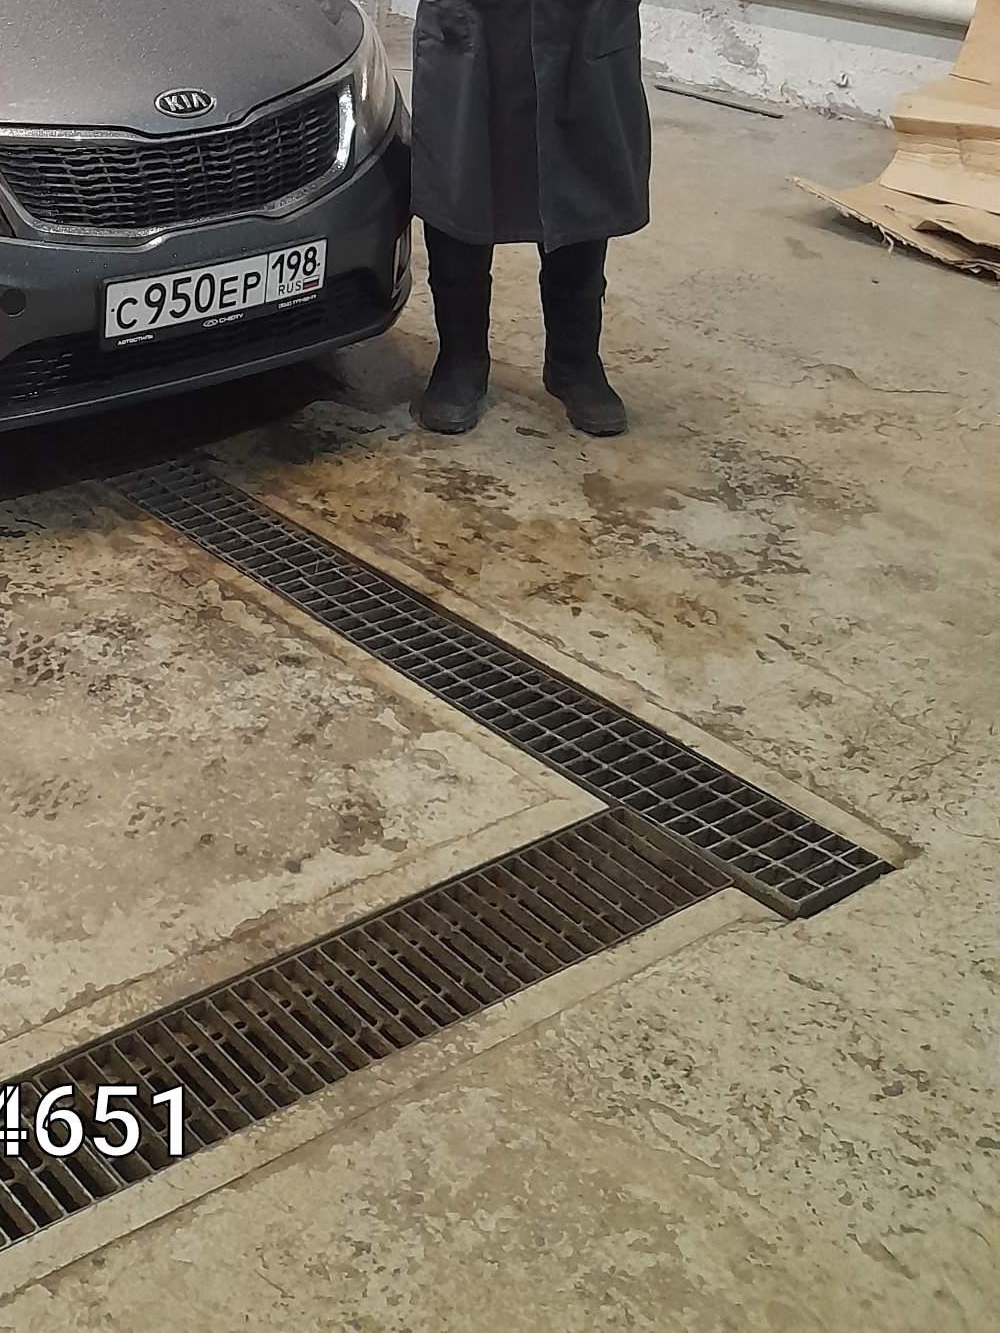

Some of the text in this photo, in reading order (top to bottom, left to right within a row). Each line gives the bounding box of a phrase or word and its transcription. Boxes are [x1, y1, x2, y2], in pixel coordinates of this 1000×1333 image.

[163, 92, 208, 112] KIA
[116, 246, 318, 329] С950ЕР 198
[278, 280, 302, 296] RUS
